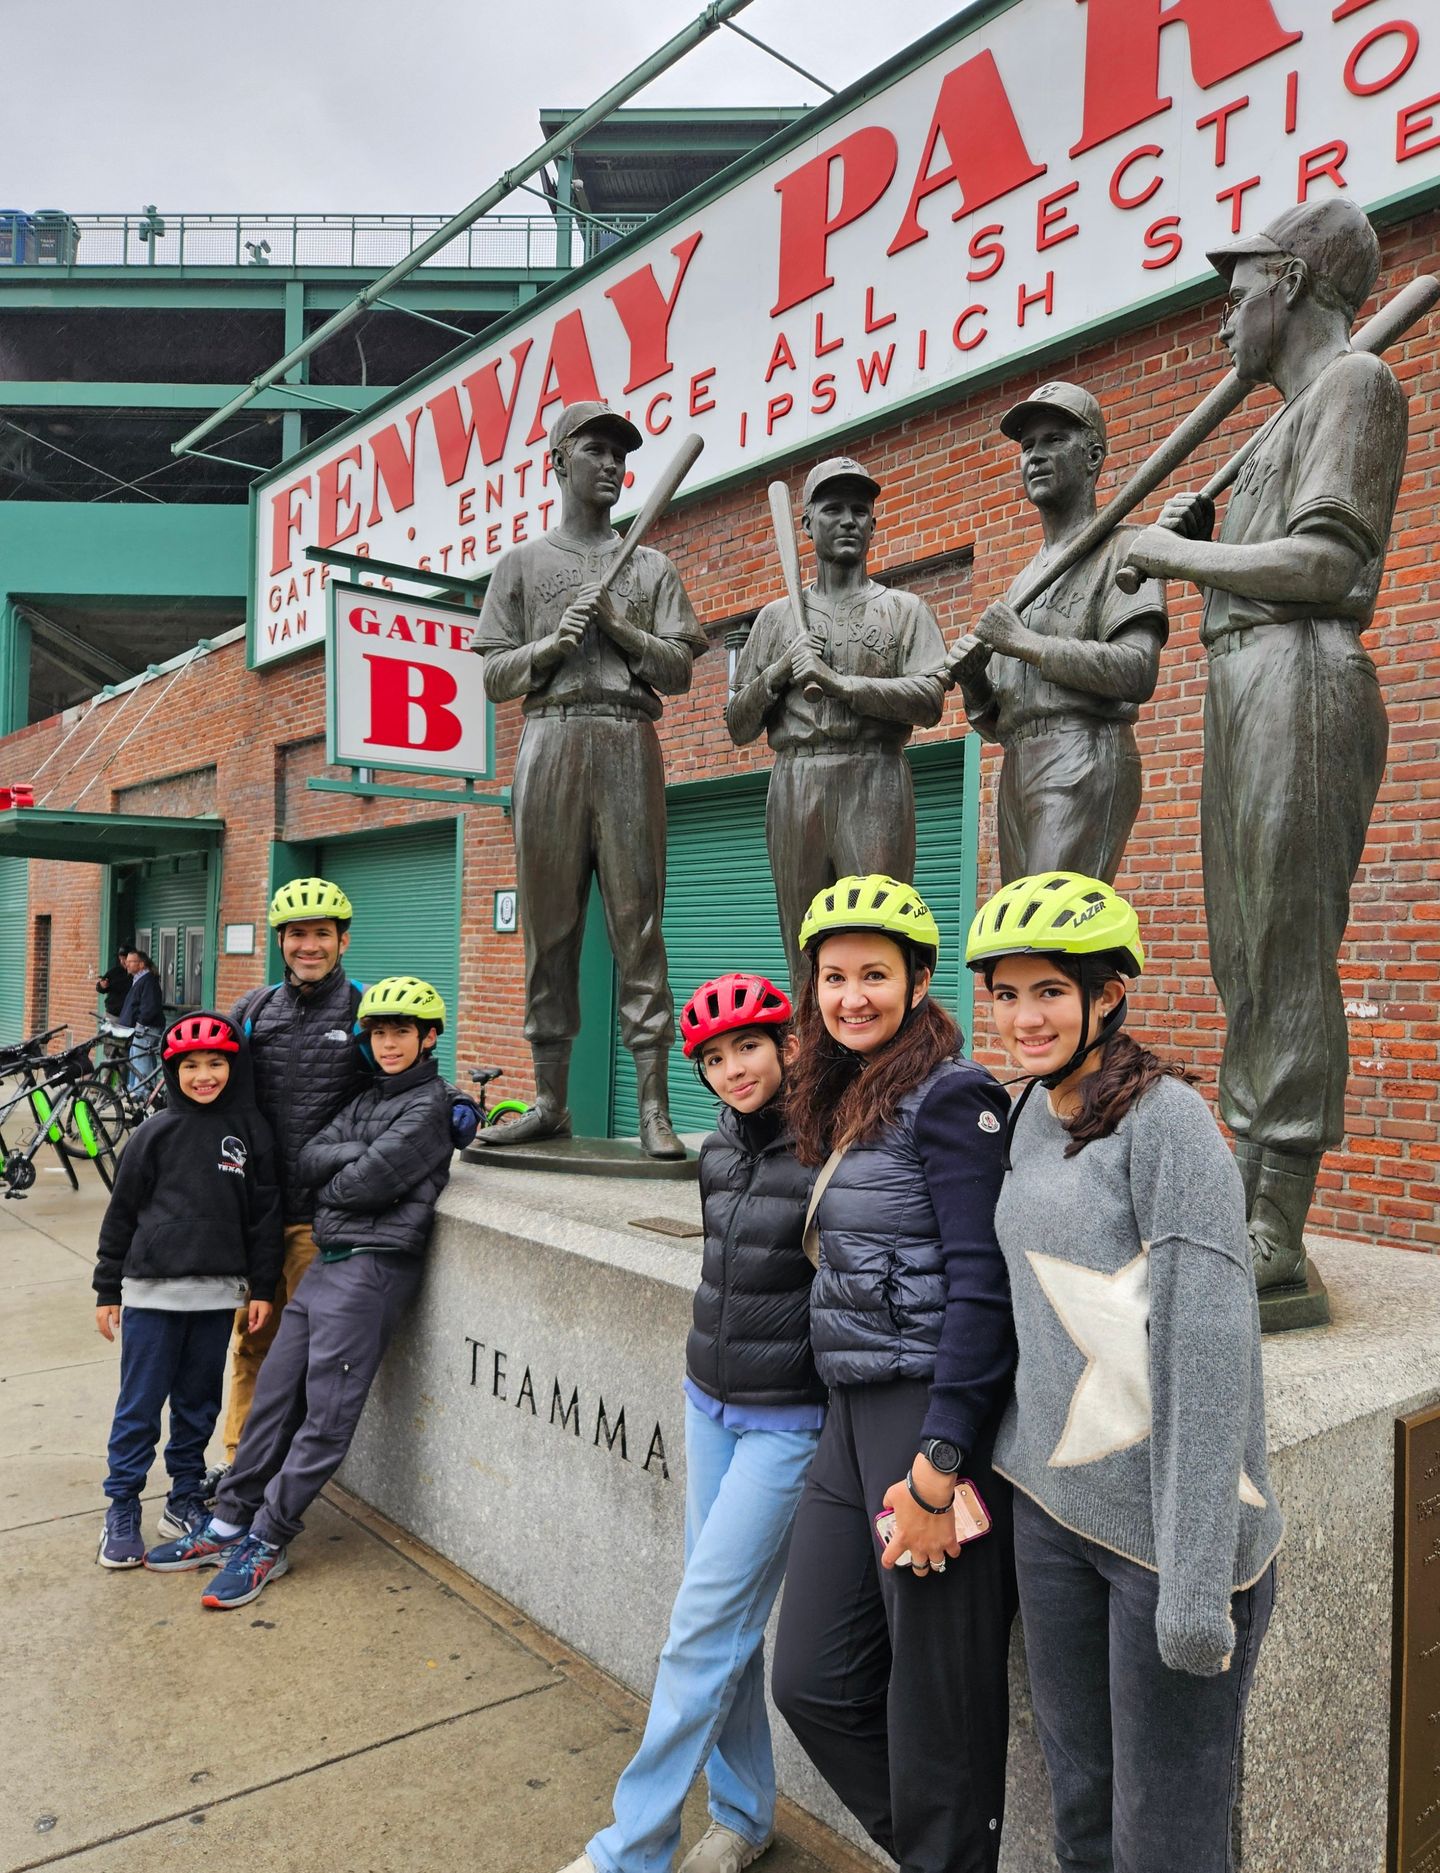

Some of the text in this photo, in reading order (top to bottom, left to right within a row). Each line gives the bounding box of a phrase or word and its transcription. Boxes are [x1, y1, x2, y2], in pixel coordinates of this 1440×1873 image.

[269, 0, 1379, 577] FENWAY PAR
[459, 367, 717, 526] ENTCE
[765, 286, 897, 383] ALL
[965, 20, 1420, 282] SECTIO
[268, 92, 1440, 645] VAN STREET IPSWICH STRE
[348, 607, 475, 653] GATE
[362, 653, 463, 752] B
[1073, 901, 1106, 928] LAZER
[465, 1336, 672, 1482] TEAMMA
